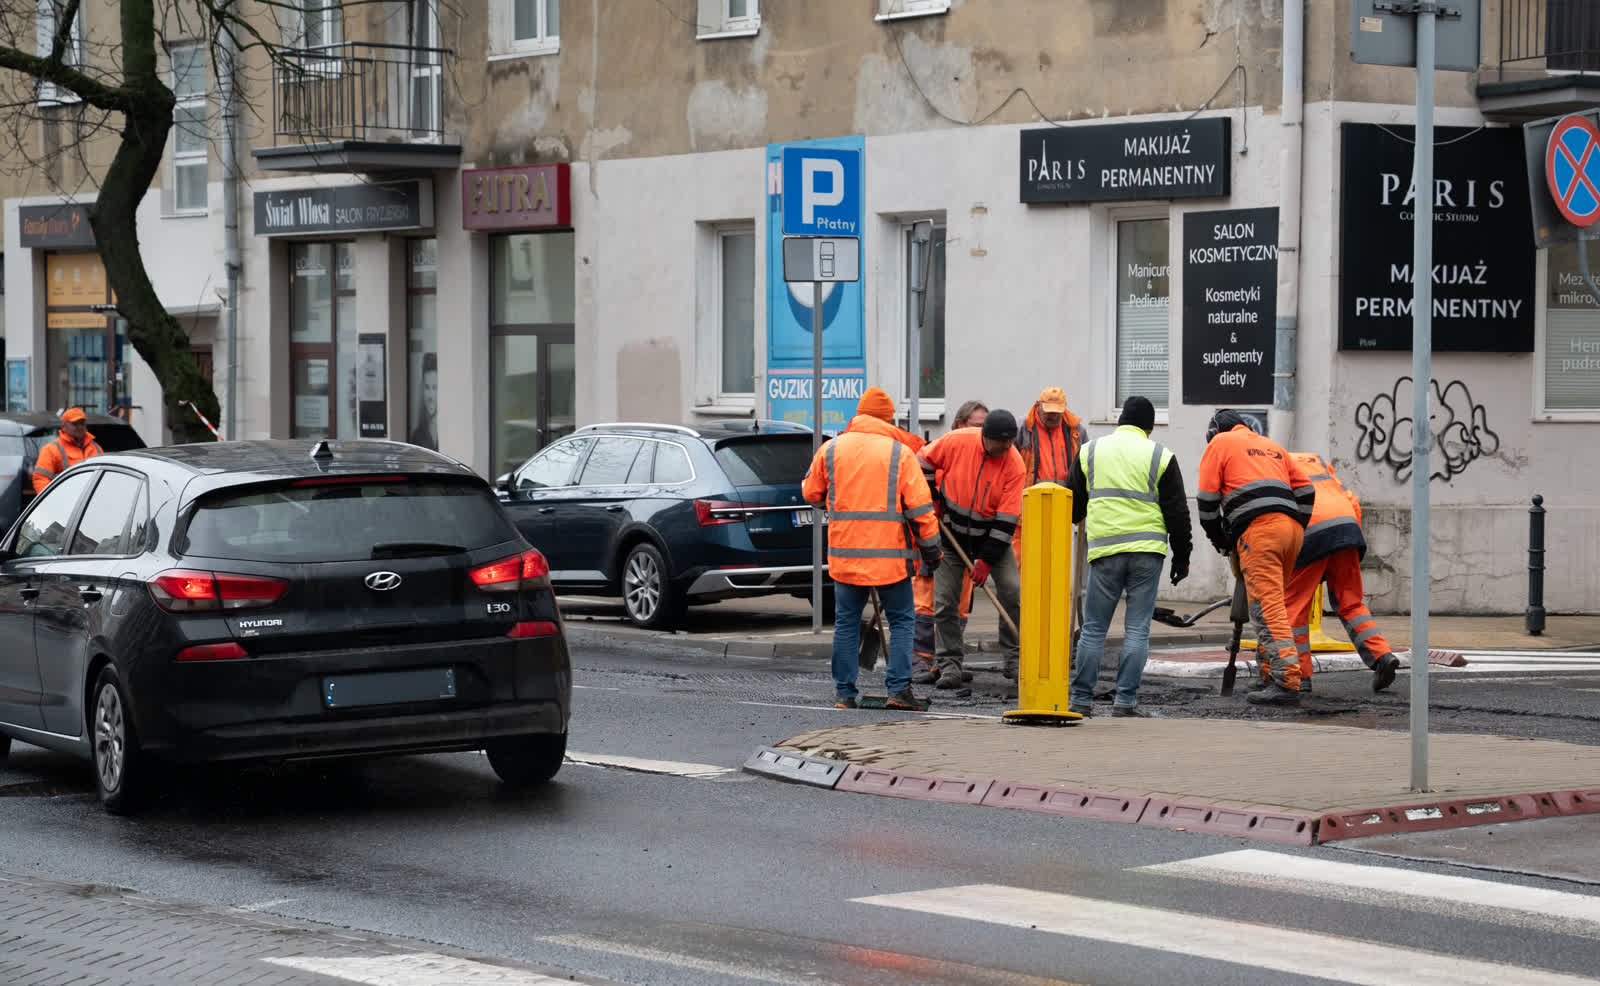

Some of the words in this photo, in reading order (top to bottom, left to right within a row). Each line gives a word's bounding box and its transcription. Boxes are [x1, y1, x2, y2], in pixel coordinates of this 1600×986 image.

[1124, 129, 1192, 157] MAKIJAŻ
[1028, 140, 1087, 181] PARIS
[1101, 164, 1216, 188] PERMANENTNY
[470, 171, 553, 215] FUTRA
[802, 158, 845, 225] P
[265, 194, 295, 227] Świat
[335, 208, 363, 224] SALON
[816, 217, 856, 233] Płatny
[1213, 223, 1255, 241] SALON
[1189, 244, 1279, 265] KOSMETYCZNY
[1128, 263, 1171, 279] Manicure
[1390, 260, 1487, 285] MKIJAŻ
[1129, 294, 1170, 308] Pedicure
[1205, 286, 1261, 307] Kosmetyki
[1207, 310, 1259, 324] naturalne
[1355, 297, 1522, 319] PERMNENTNY
[1230, 332, 1238, 344] &
[1202, 348, 1264, 365] suplementy
[768, 377, 814, 399] GUZIKI
[1219, 370, 1247, 389] diety
[821, 410, 846, 424] ETAL
[239, 619, 283, 629] HYUNDAI
